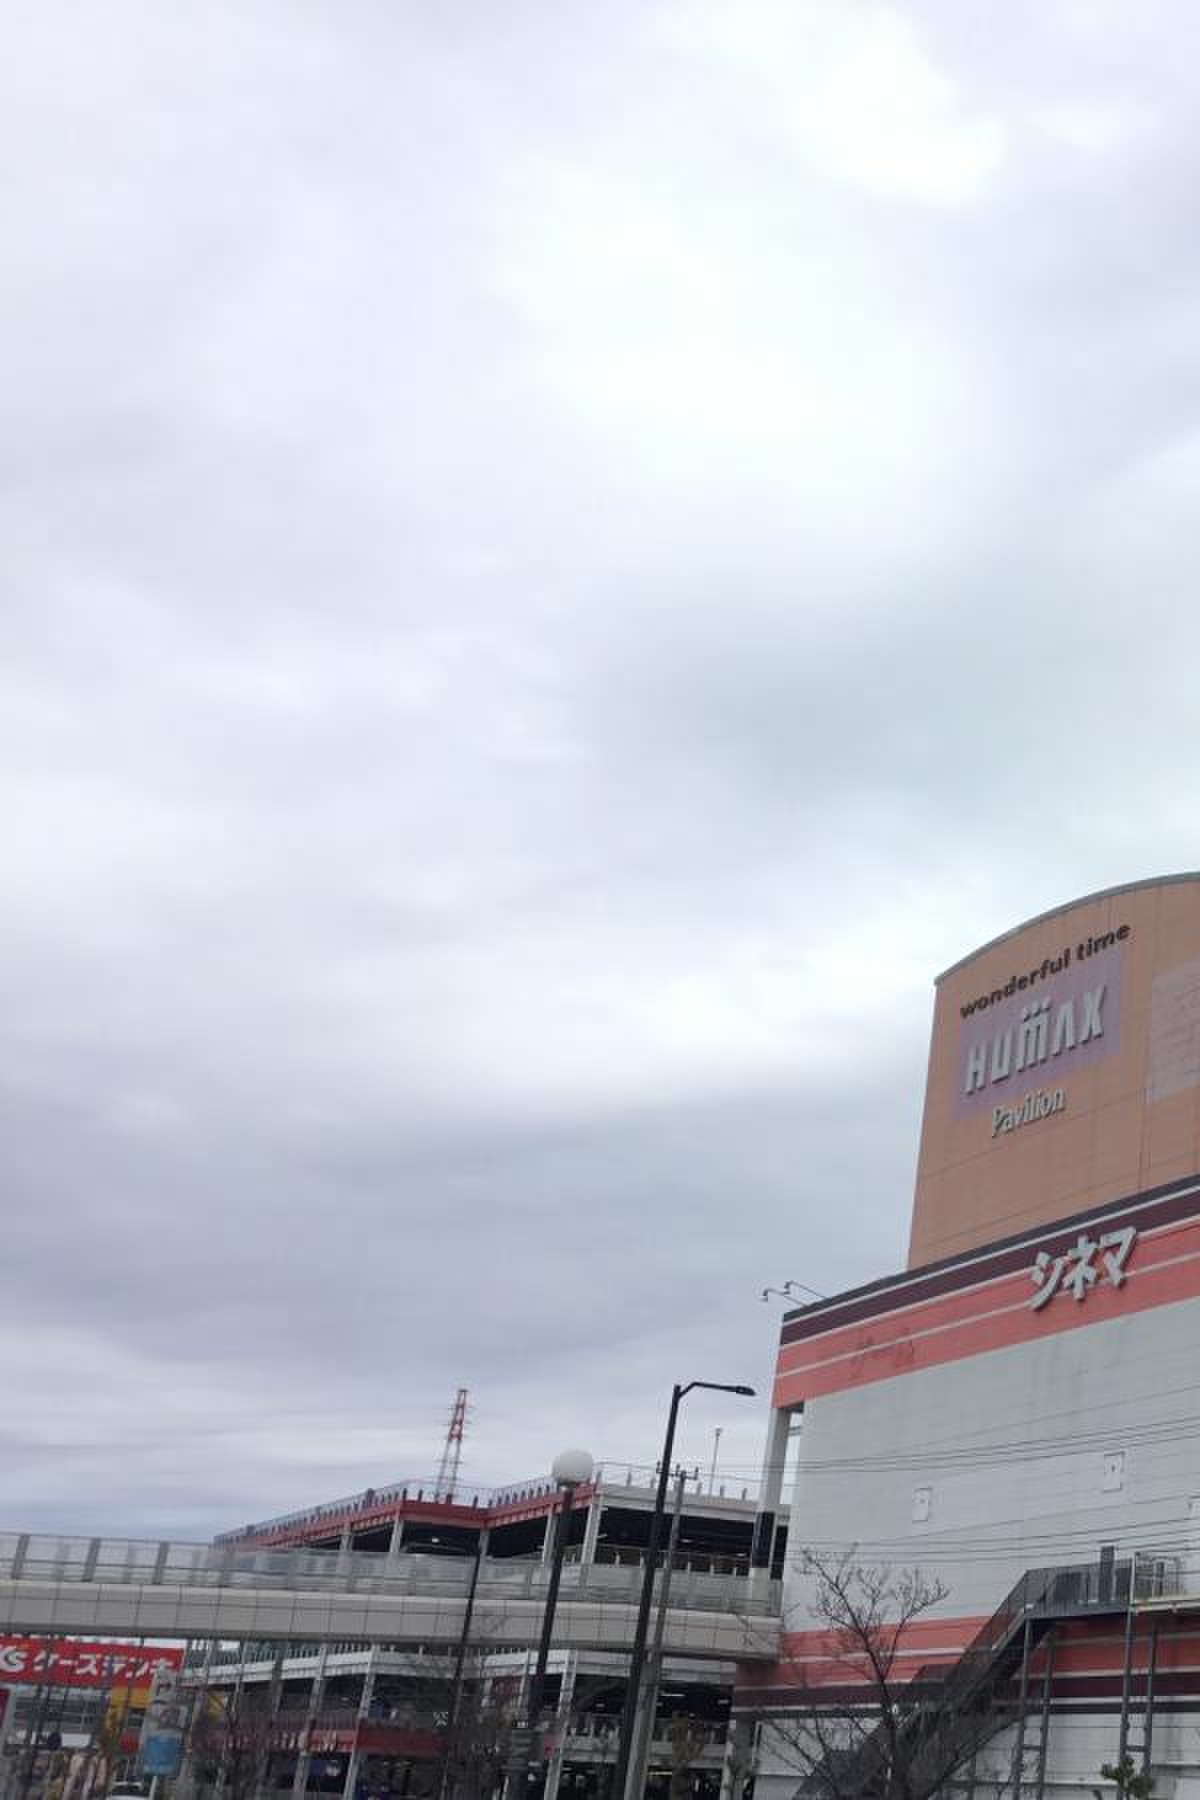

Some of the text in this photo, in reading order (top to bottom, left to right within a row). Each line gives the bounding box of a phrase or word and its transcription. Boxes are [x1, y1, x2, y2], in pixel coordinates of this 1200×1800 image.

[960, 924, 1131, 1019] wonderful time
[991, 1087, 1067, 1138] Pavilion
[1024, 1226, 1137, 1311] シネマ
